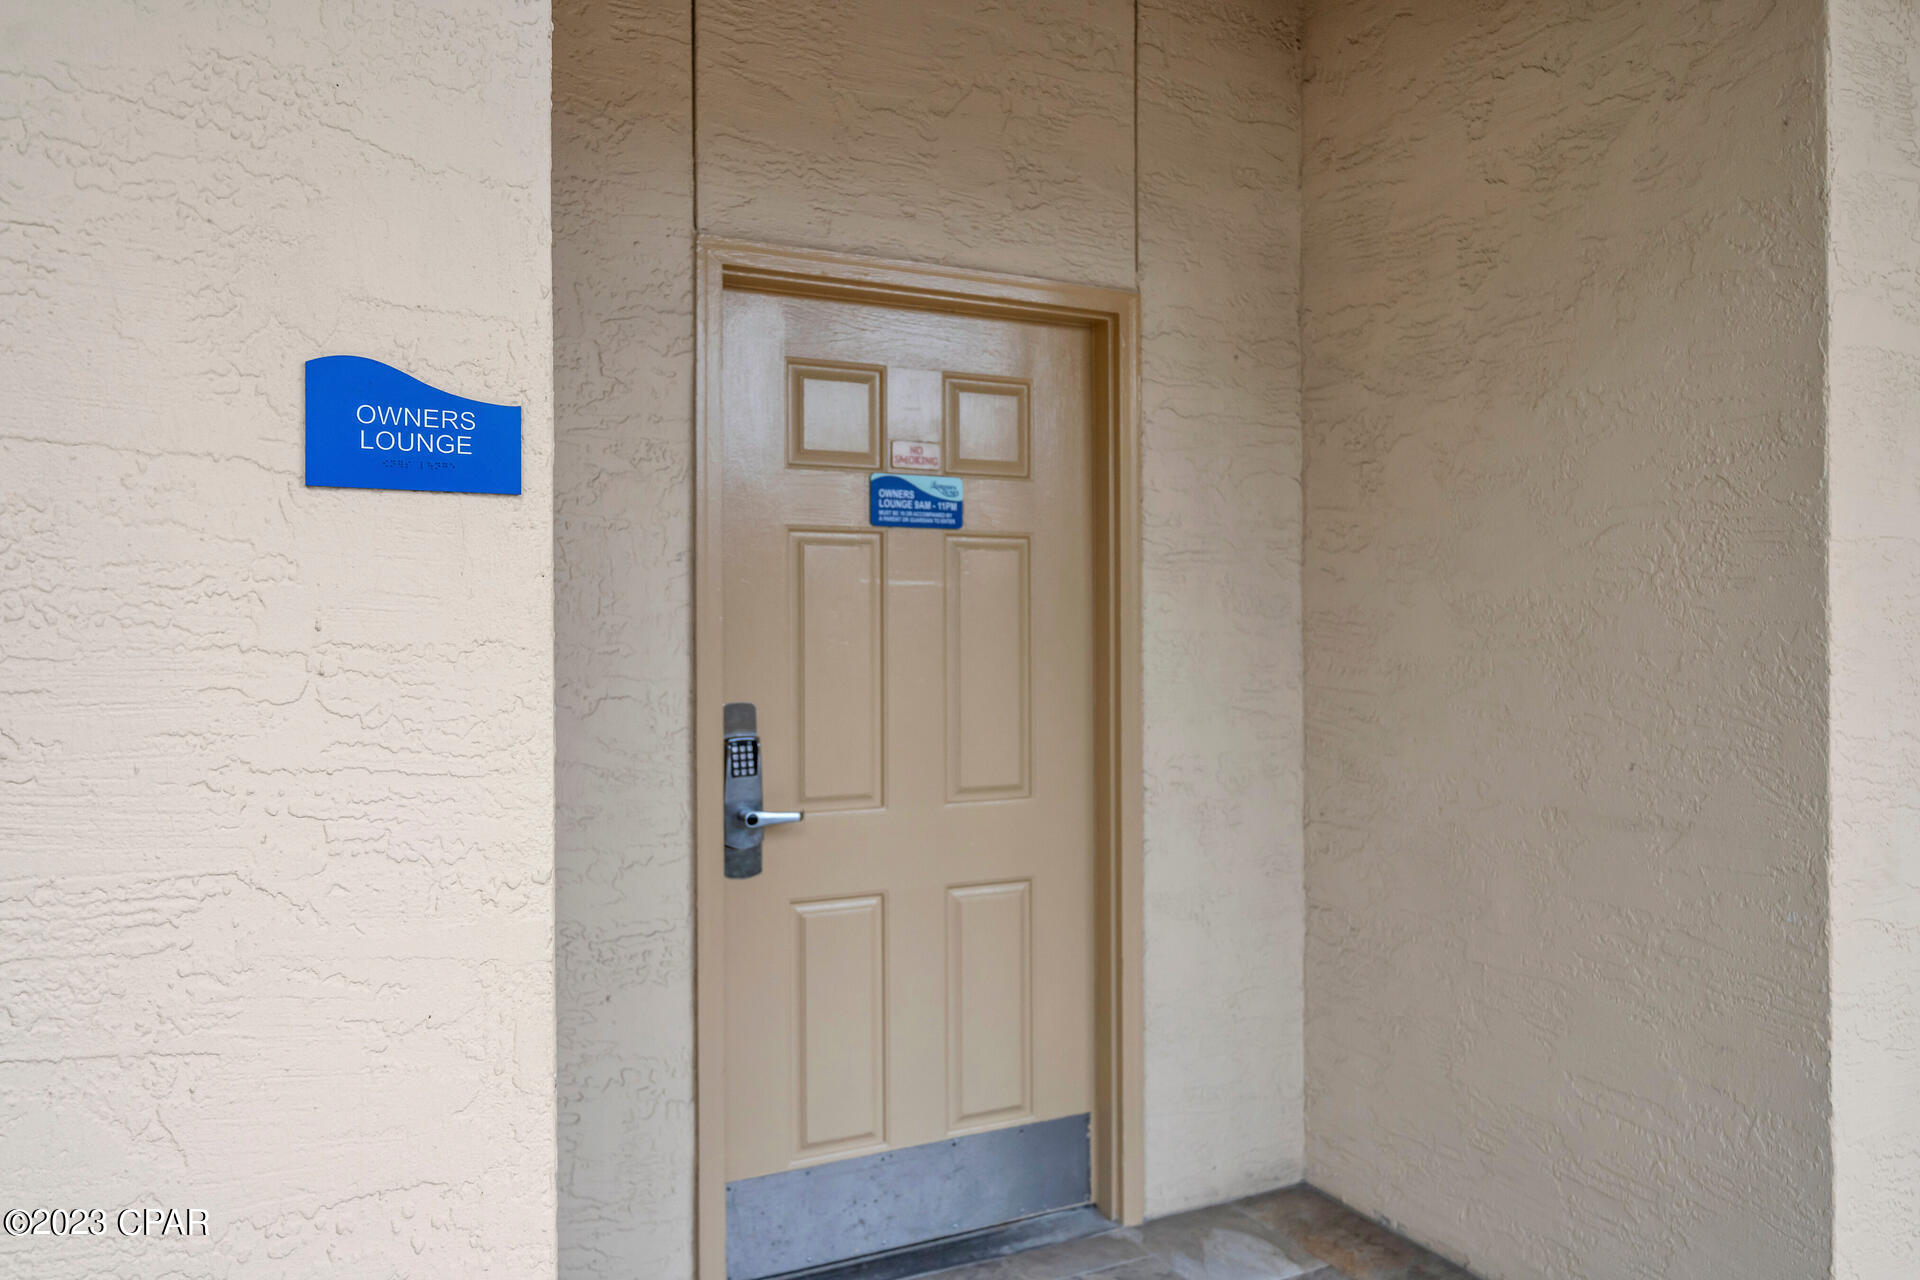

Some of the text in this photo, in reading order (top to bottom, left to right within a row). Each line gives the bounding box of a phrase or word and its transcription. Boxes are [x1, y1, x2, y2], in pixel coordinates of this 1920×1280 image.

[356, 404, 476, 431] OWNERS
[359, 429, 473, 455] LOUNGE
[910, 446, 924, 455] NO
[895, 455, 938, 466] SMOKING
[878, 488, 915, 499] OWNERS
[878, 499, 913, 510] LOUNGE
[914, 500, 932, 510] 9AM
[937, 501, 958, 511] 11PM
